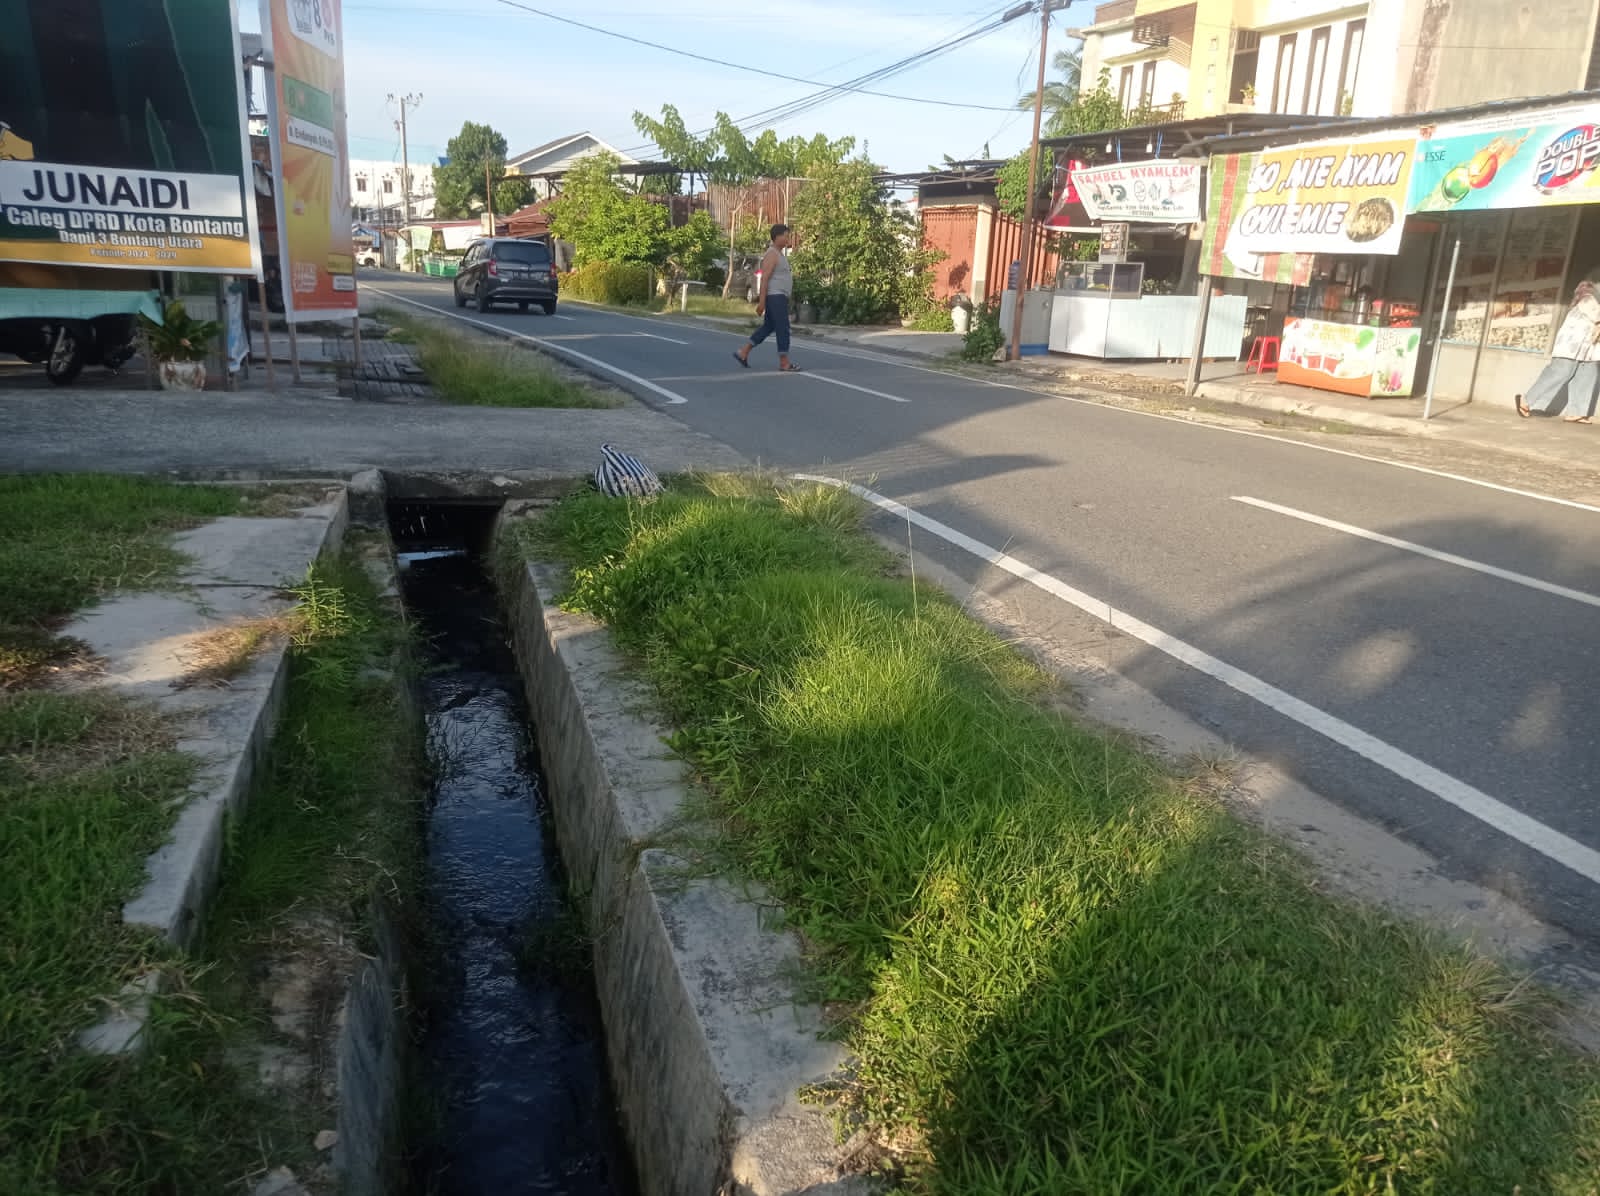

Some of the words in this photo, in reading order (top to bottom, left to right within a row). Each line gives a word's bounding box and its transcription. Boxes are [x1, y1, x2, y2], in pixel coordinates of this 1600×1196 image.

[1424, 151, 1446, 162] ESSE
[1540, 124, 1600, 162] DOUBLE
[1077, 170, 1127, 185] SAMBEL
[1332, 151, 1406, 188] AYAM
[1533, 142, 1600, 187] POP
[23, 169, 190, 210] JUNAIDI
[7, 205, 67, 230] Caleg
[68, 209, 120, 232] DPRD
[123, 215, 166, 234] Kota
[169, 216, 245, 238] Bontang
[59, 230, 96, 245] Dapil
[98, 232, 107, 245] 3
[110, 232, 166, 249] Bontang
[168, 235, 204, 249] Utara
